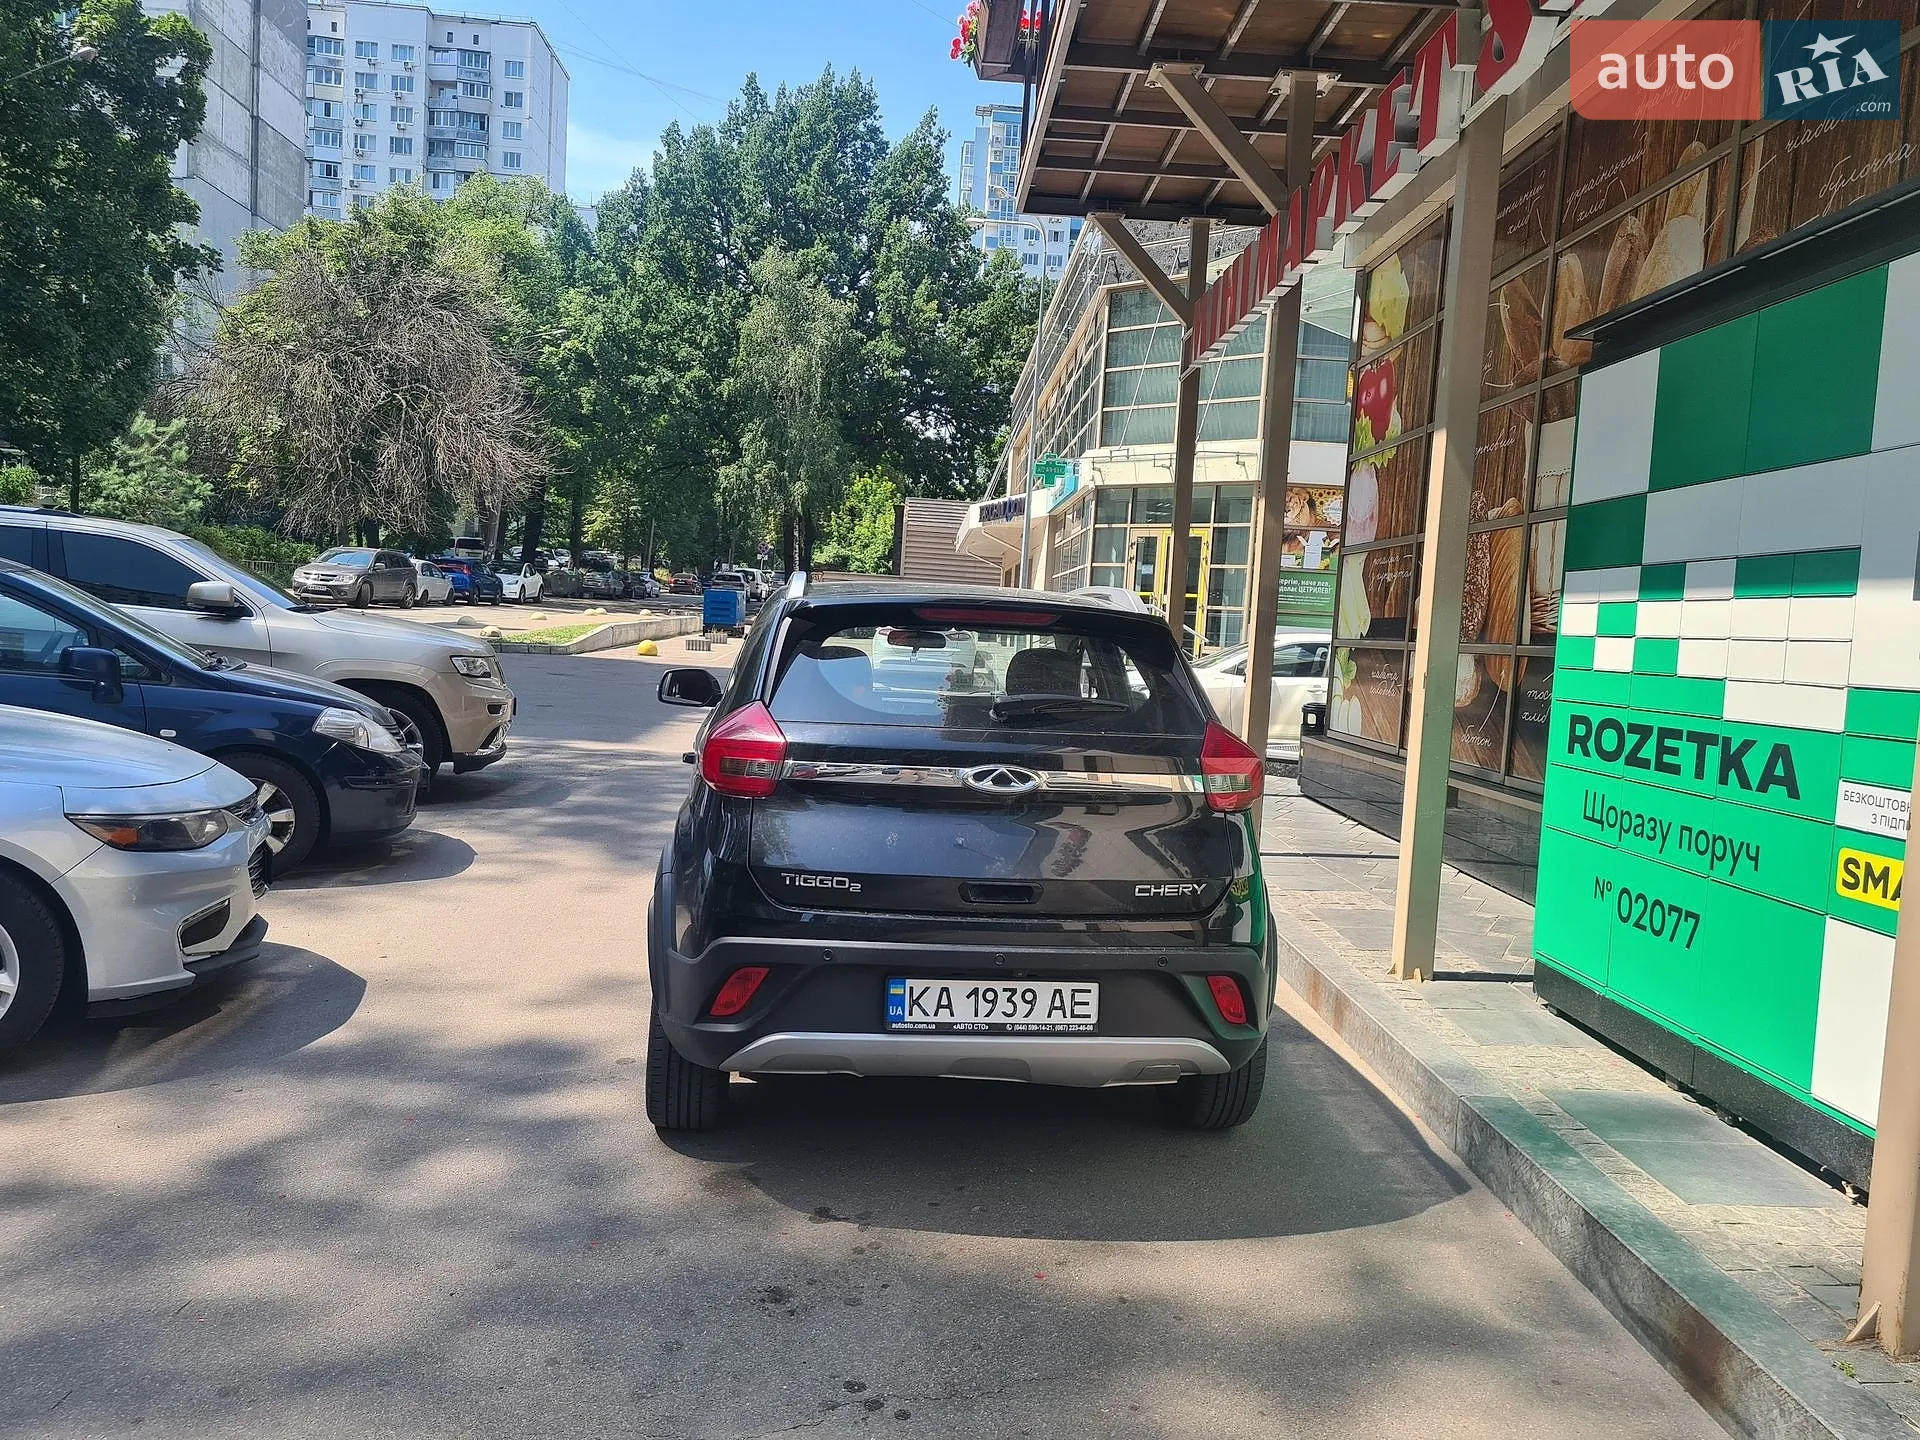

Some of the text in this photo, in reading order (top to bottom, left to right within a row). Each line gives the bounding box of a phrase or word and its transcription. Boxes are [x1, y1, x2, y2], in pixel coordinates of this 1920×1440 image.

[1819, 141, 1917, 218] булочка
[1567, 714, 1801, 800] ROZETKA
[1582, 789, 1761, 876] Щоразу поруч
[1134, 882, 1208, 898] CHERY
[1616, 887, 1701, 951] 02077
[889, 1005, 903, 1016] UA
[908, 986, 1092, 1019] KA 1939 AE
